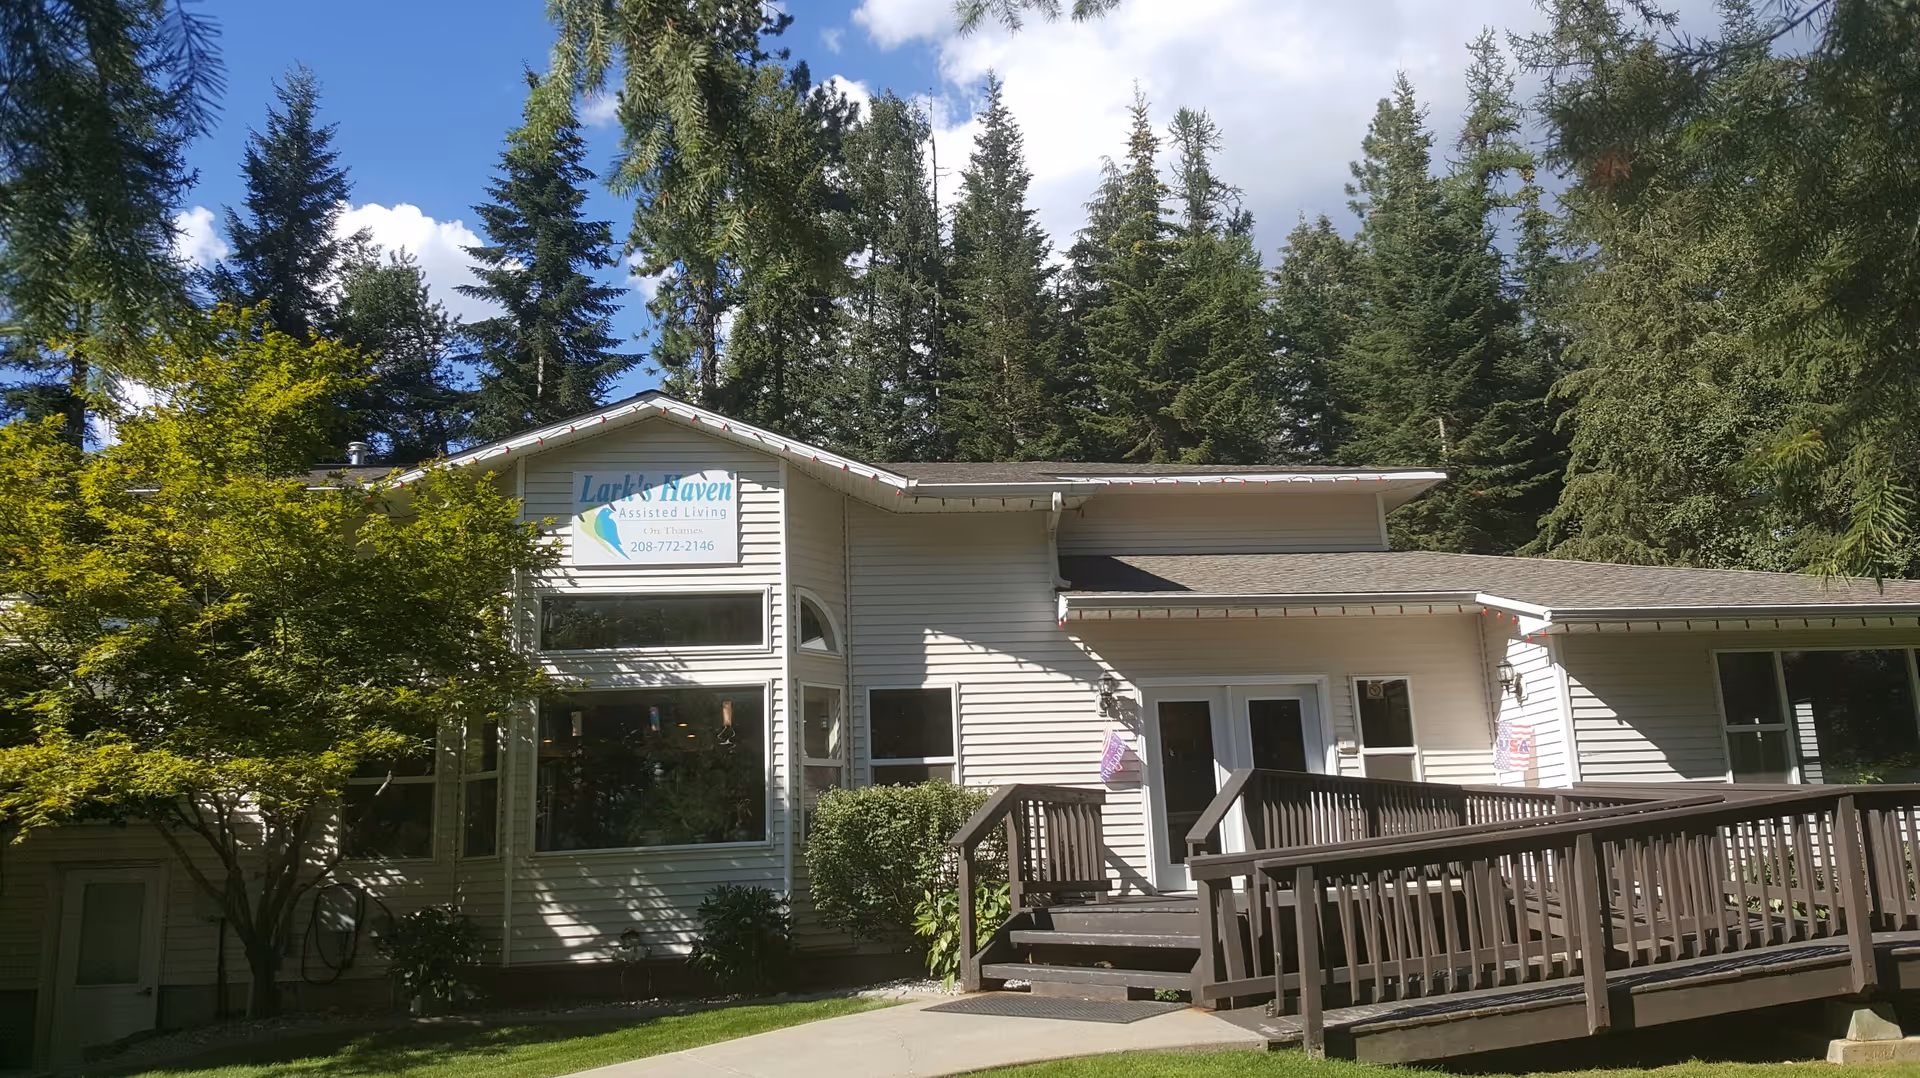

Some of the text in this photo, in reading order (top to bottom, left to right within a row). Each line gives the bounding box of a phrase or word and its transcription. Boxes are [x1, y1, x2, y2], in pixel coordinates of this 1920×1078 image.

[580, 474, 732, 503] Lark's Haven
[619, 506, 727, 520] Assisted Living
[643, 525, 704, 535] On Thames
[630, 540, 715, 553] 208-772-2146
[1499, 739, 1529, 752] USA
